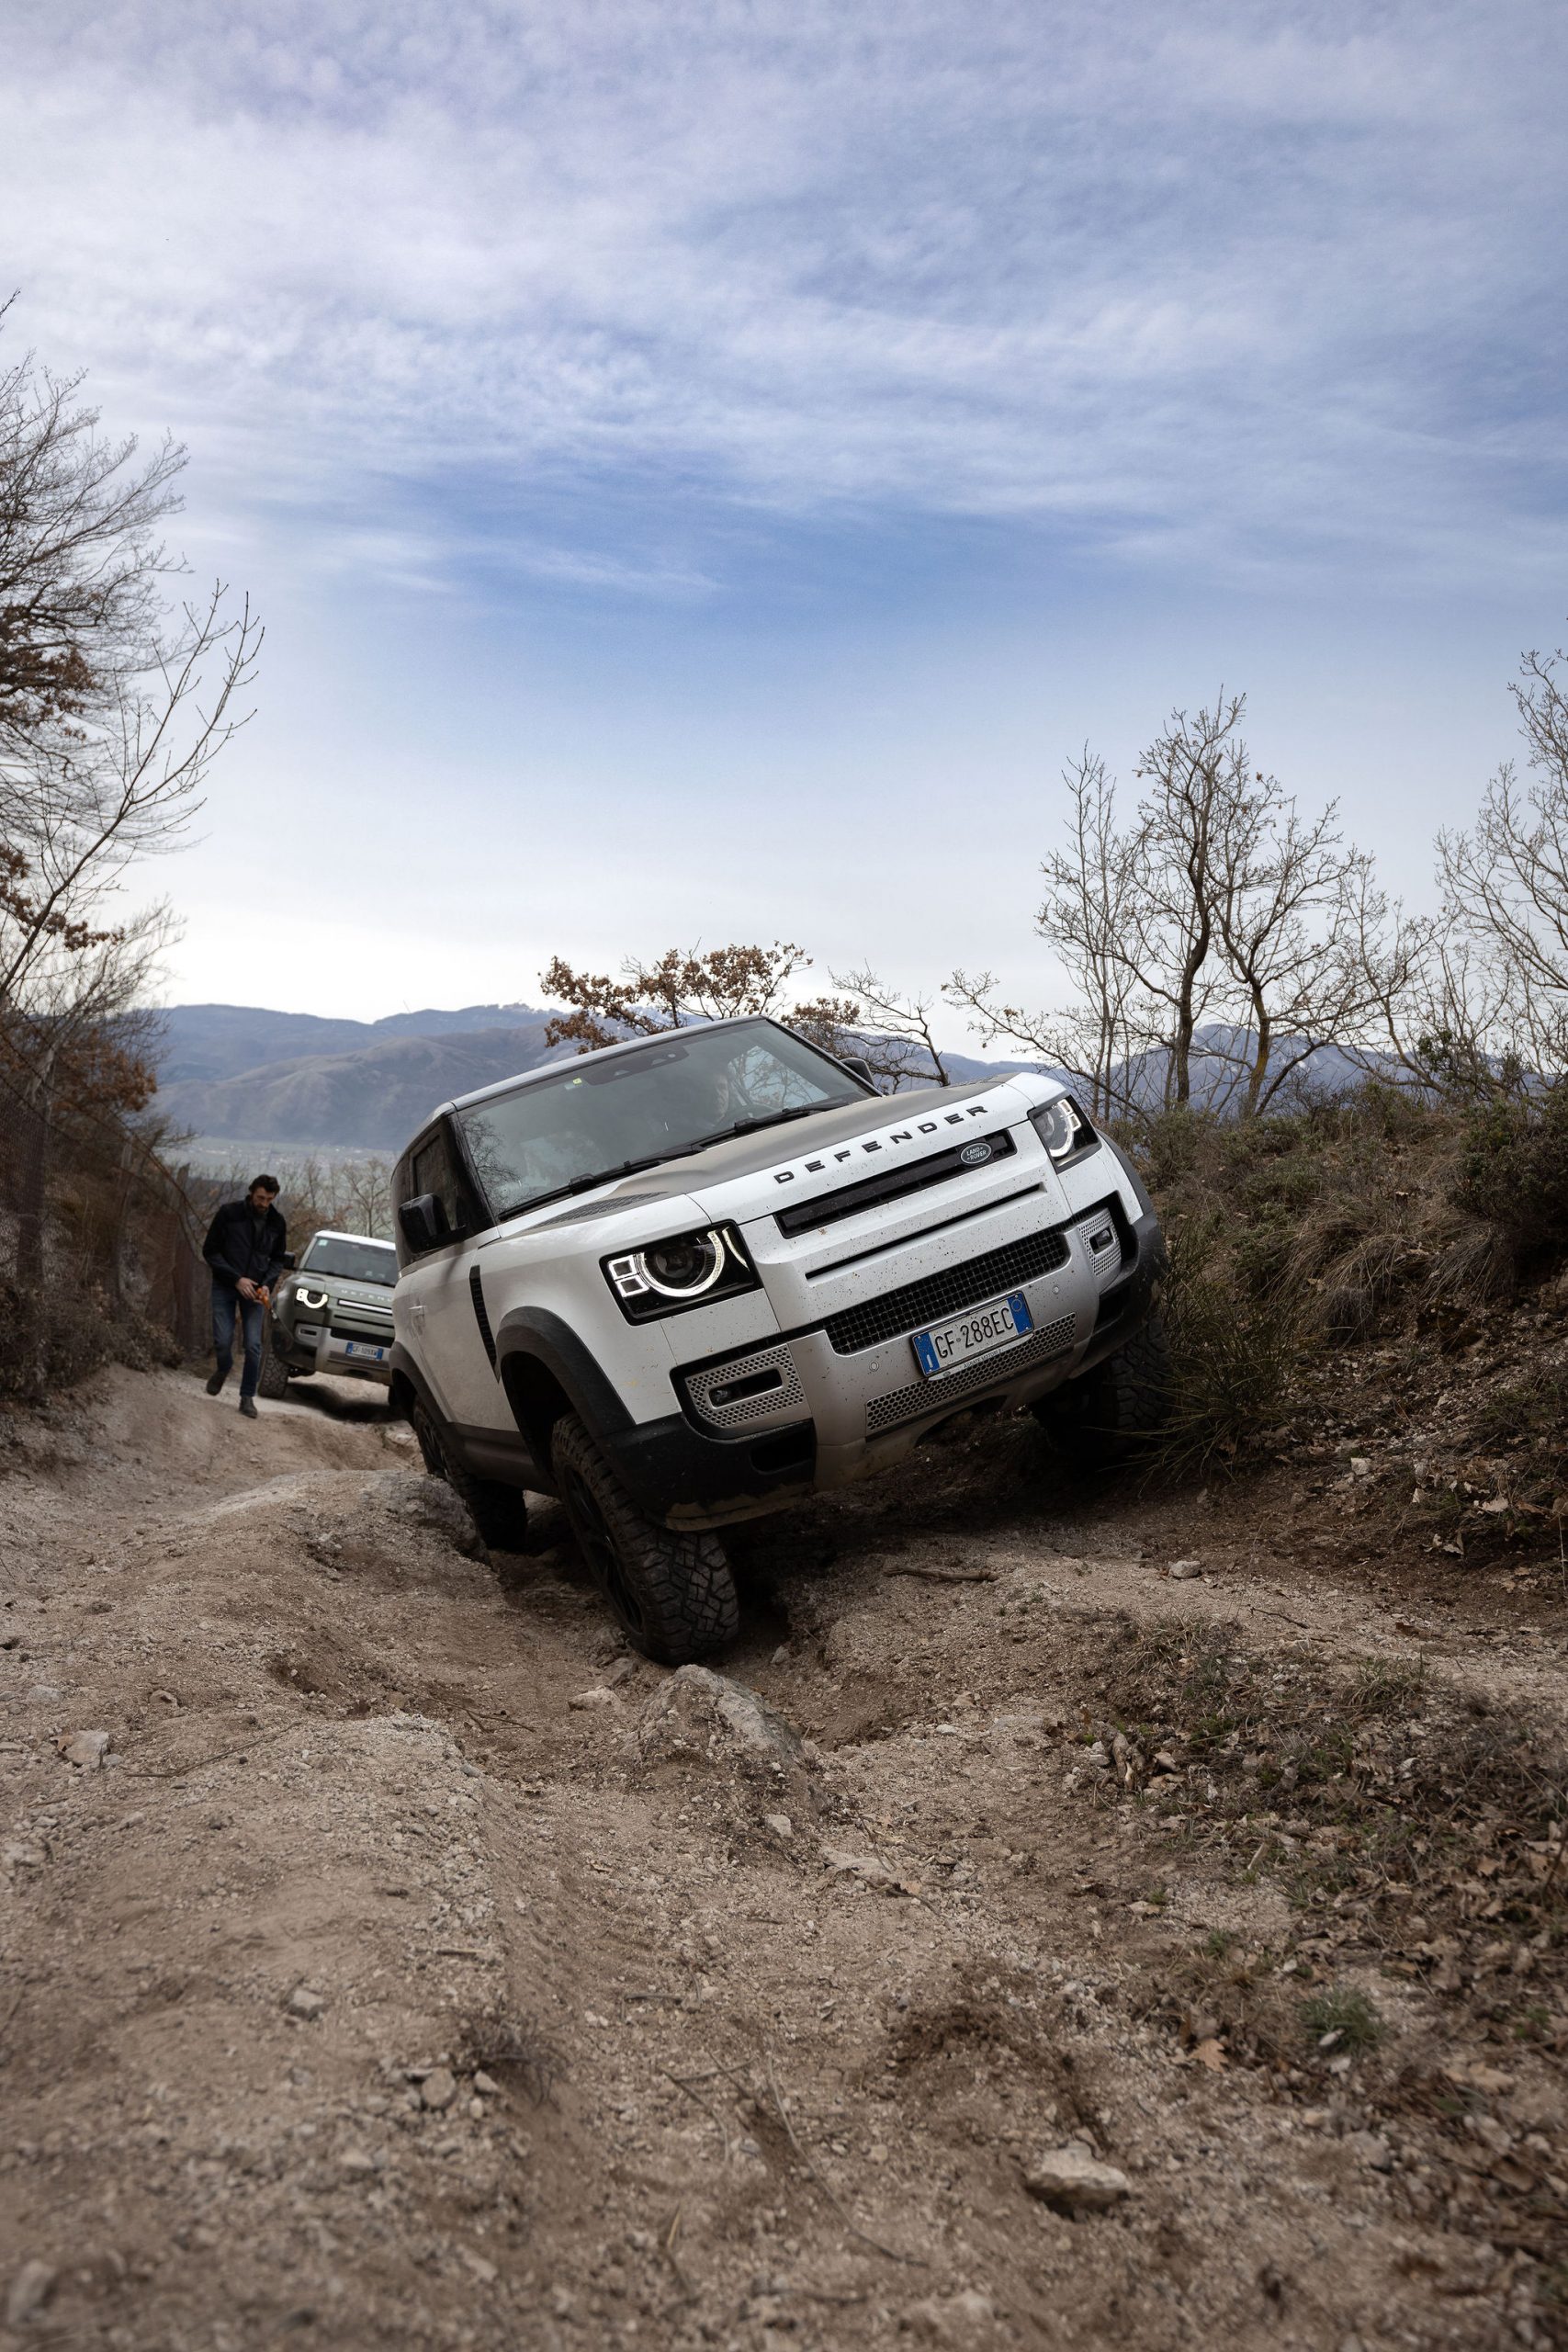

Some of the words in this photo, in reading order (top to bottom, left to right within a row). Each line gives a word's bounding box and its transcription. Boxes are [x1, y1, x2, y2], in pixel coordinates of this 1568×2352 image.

[773, 1105, 988, 1184] DEFENDER
[966, 1147, 980, 1157] LAND
[969, 1150, 987, 1160] ROVER
[934, 1330, 955, 1359] GF
[960, 1307, 1014, 1349] 288EC
